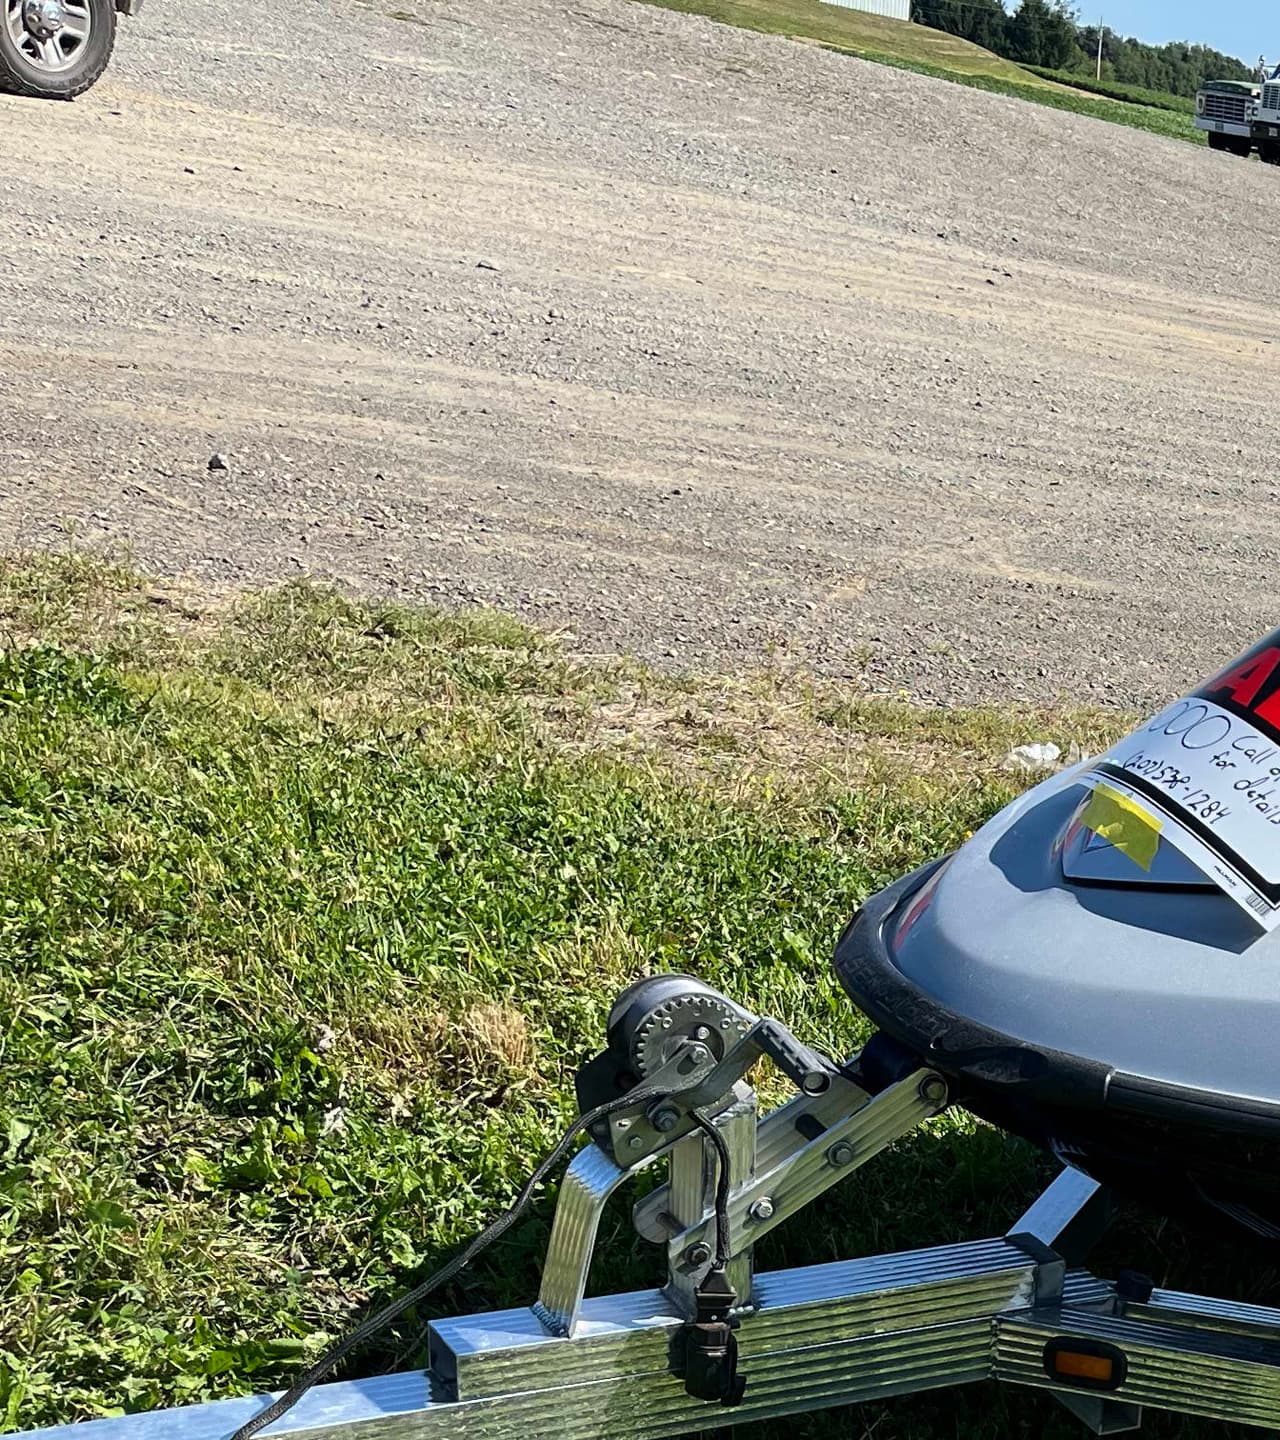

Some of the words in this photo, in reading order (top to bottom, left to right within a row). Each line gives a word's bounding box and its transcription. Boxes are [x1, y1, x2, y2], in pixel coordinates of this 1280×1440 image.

[1146, 701, 1231, 750] 000
[1209, 750, 1237, 771] for
[1231, 735, 1278, 764] Call
